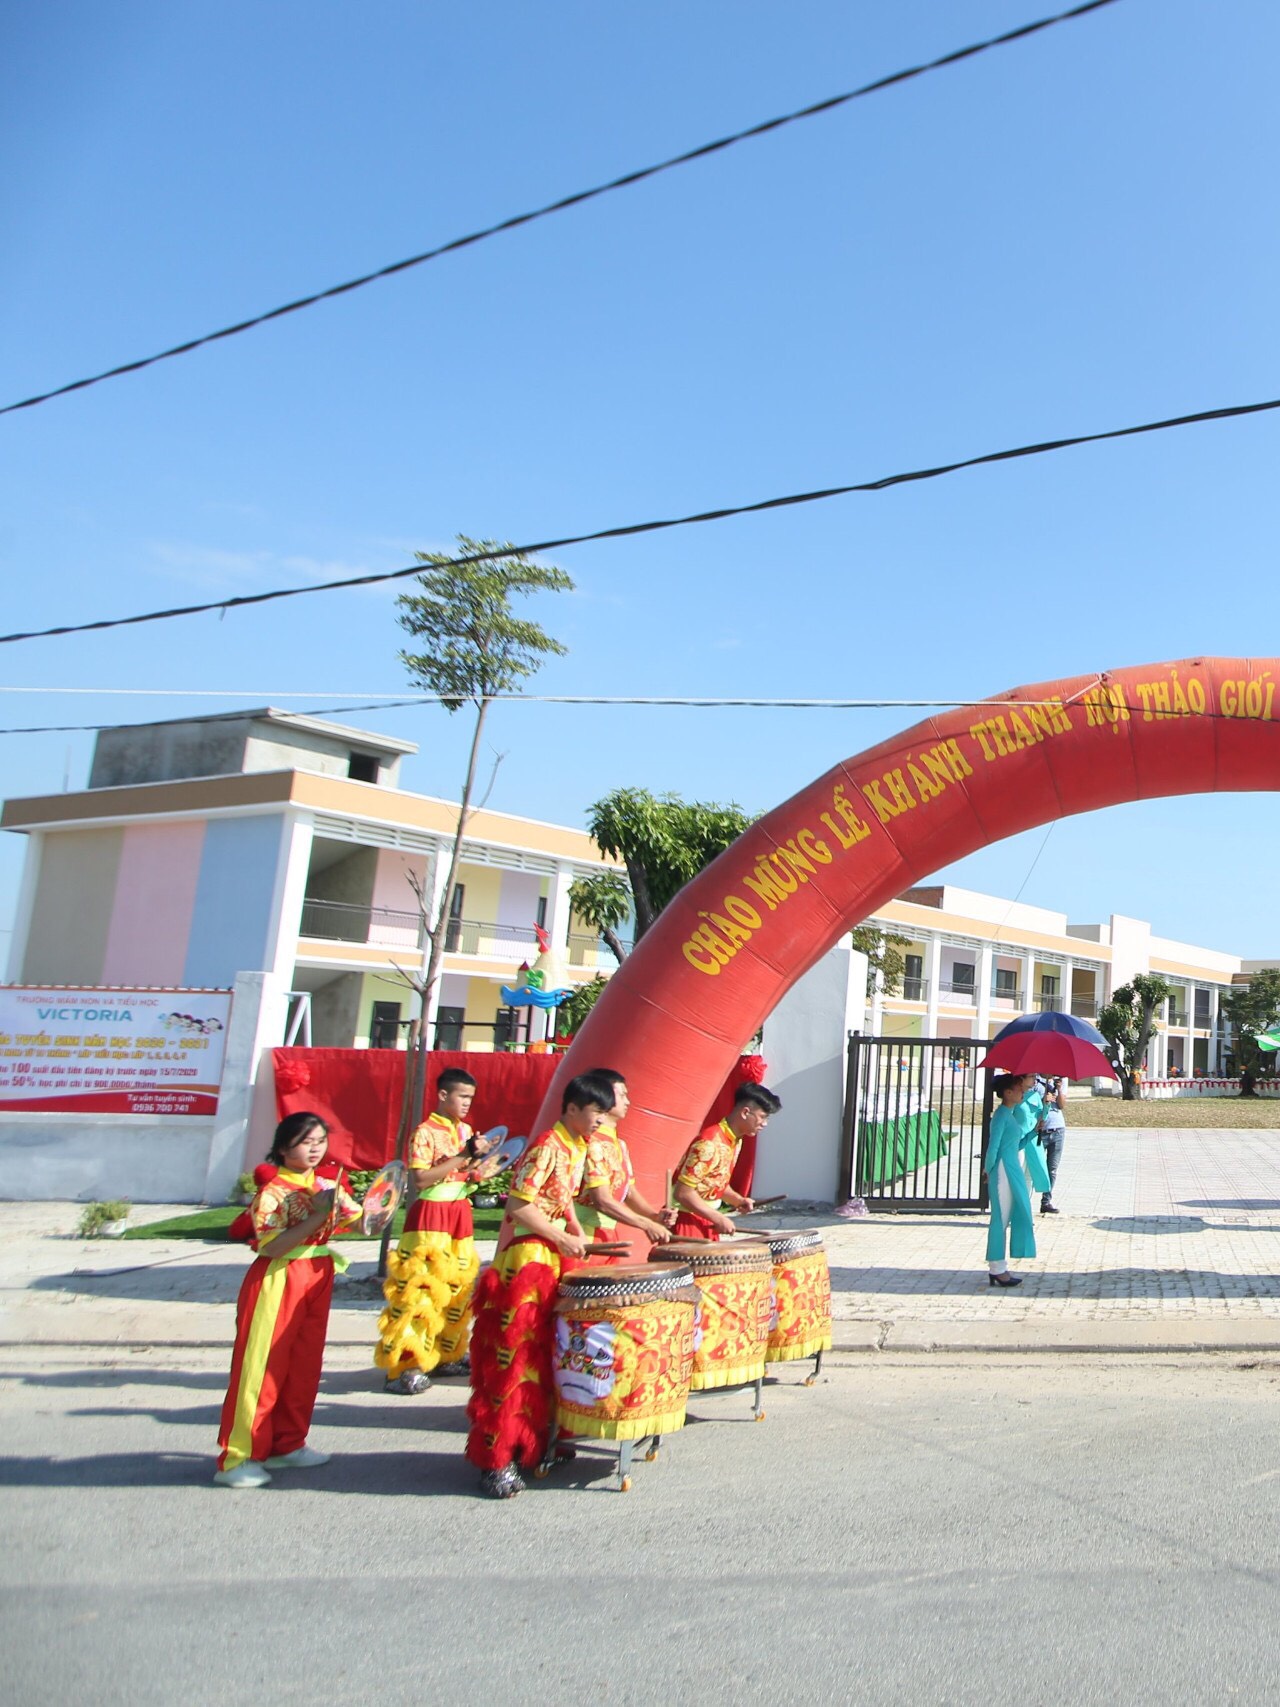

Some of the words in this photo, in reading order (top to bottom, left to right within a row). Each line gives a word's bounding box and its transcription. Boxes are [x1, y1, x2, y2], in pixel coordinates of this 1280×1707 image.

[682, 895, 763, 976] CHÀO
[820, 784, 872, 850] LỄ
[862, 738, 974, 824] KHÁNH
[969, 695, 1073, 762] THÀNH
[1136, 669, 1206, 722] THẢO
[1219, 671, 1276, 722] GIỚI
[37, 1008, 133, 1022] VICTORIA
[11, 1062, 32, 1074] 100
